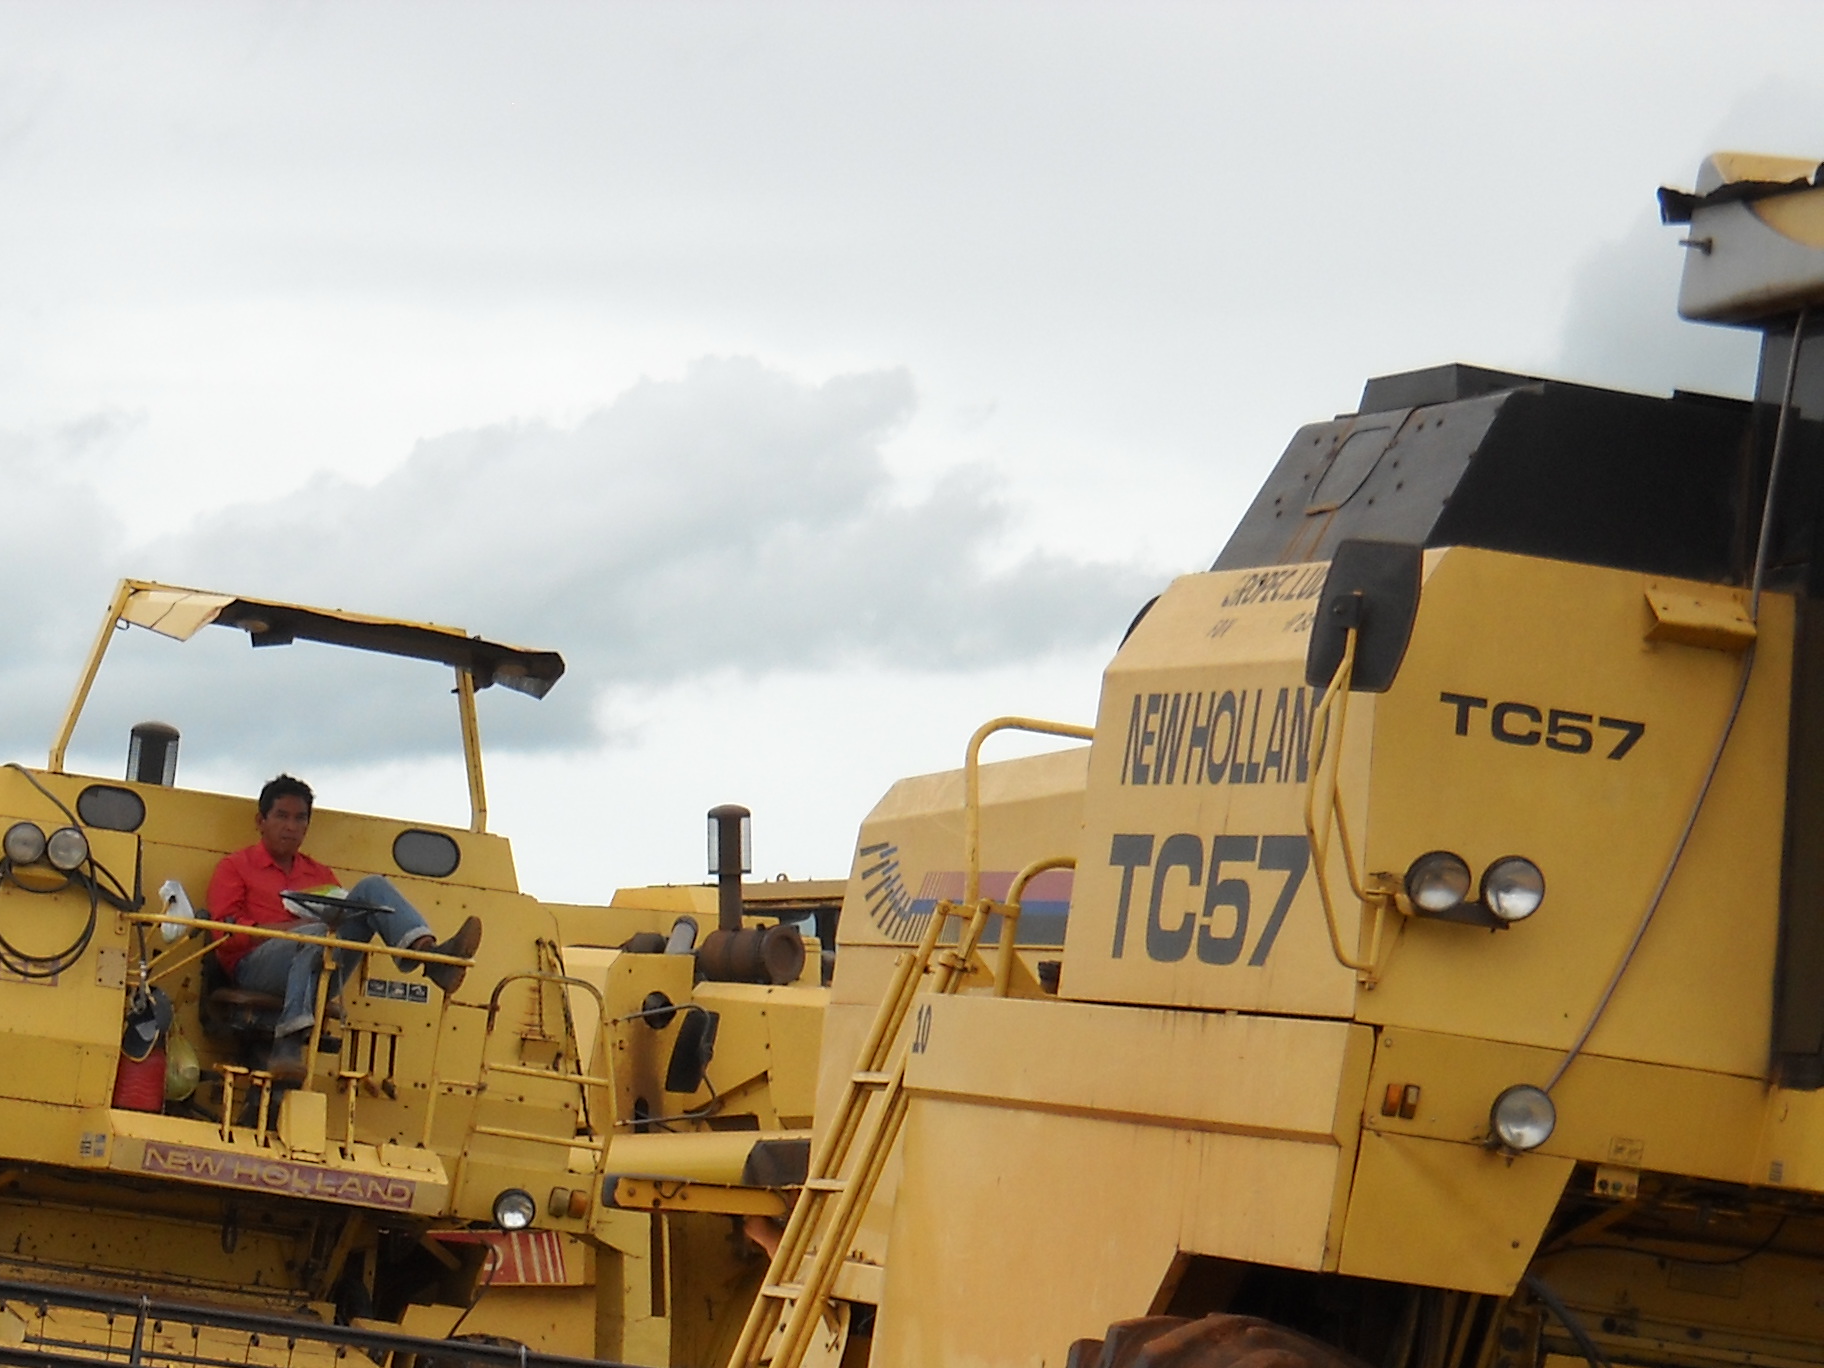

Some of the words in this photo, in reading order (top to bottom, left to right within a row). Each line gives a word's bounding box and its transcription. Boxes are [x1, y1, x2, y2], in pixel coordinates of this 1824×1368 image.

[1440, 692, 1645, 760] TC57
[1109, 833, 1312, 966] TC57
[145, 1148, 224, 1177] NEW
[233, 1160, 412, 1204] HOLLAND
